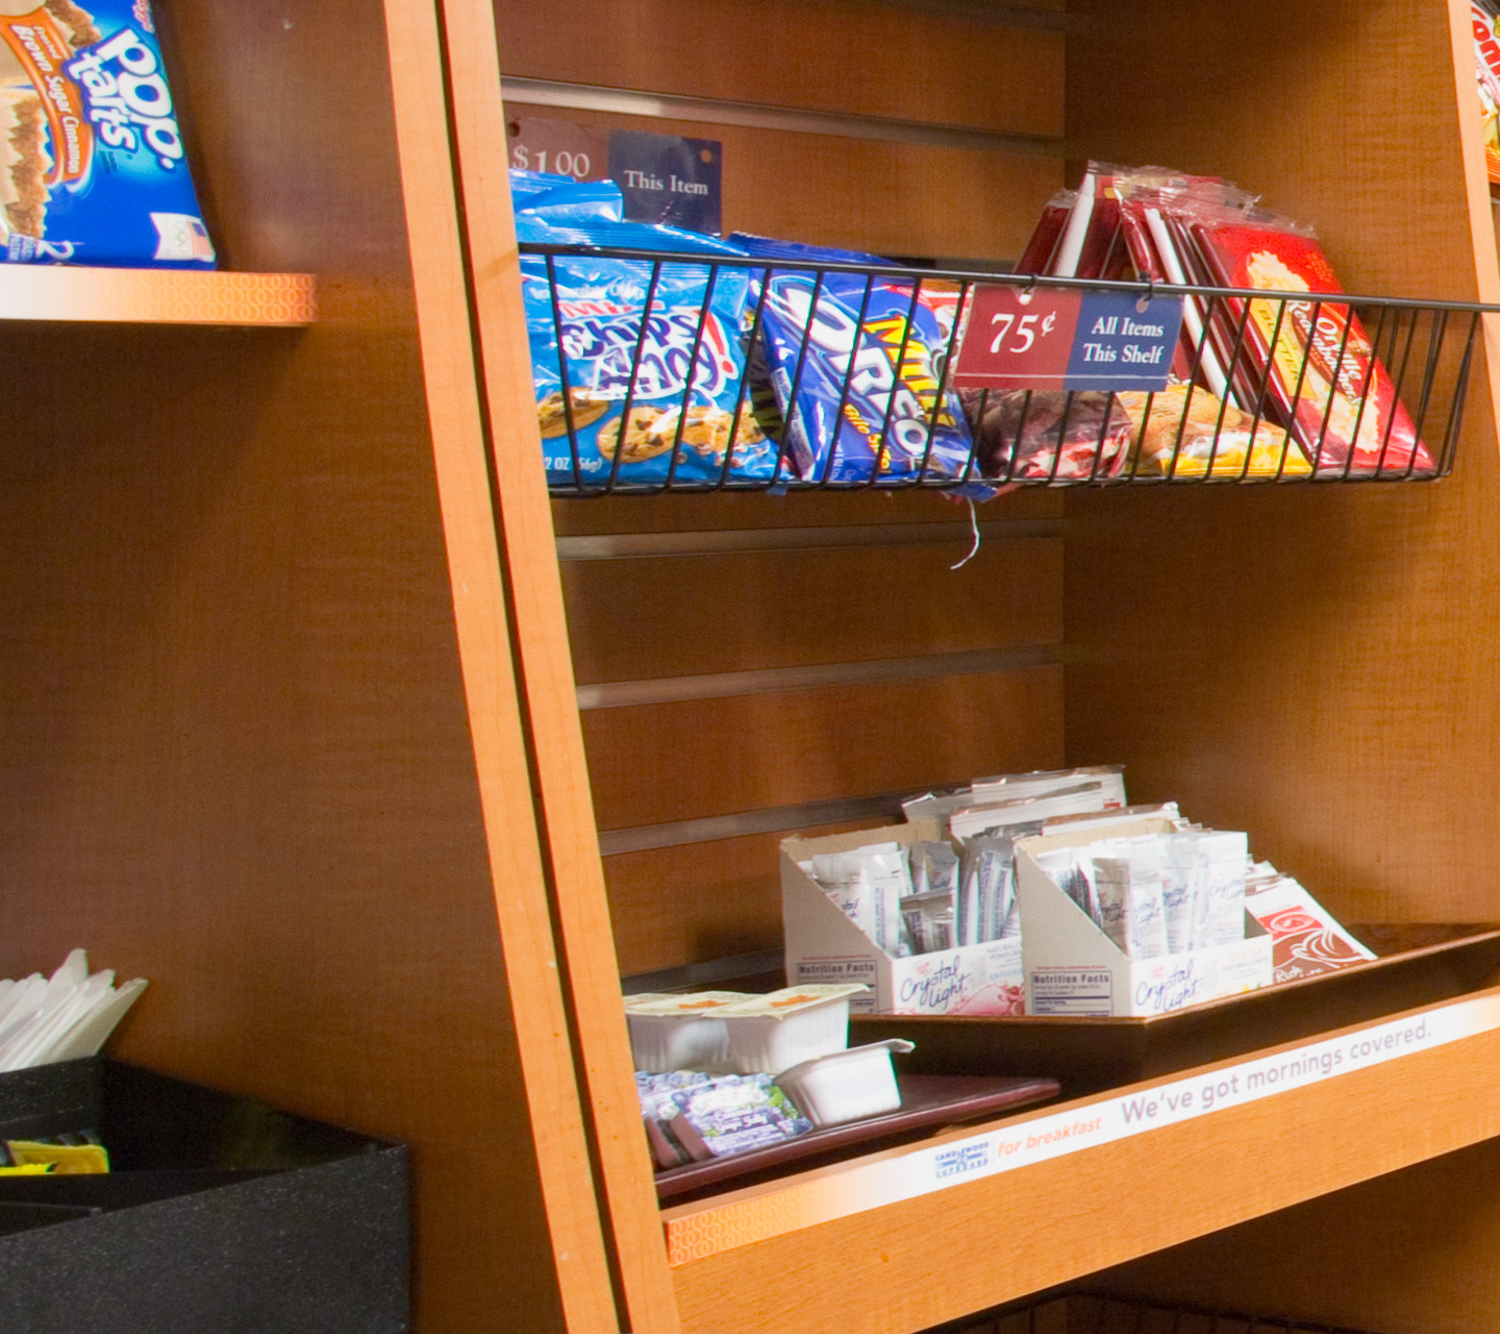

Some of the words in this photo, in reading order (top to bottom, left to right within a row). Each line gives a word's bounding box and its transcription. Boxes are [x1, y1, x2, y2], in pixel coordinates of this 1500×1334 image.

[11, 24, 53, 72] Brown
[46, 75, 73, 112] Sugar
[62, 116, 81, 174] Cinnamon
[624, 170, 664, 191] This
[670, 174, 709, 196] Item
[990, 311, 1056, 354] 75¢
[1092, 316, 1118, 336] All
[1121, 319, 1164, 337] Items
[771, 277, 931, 457] OREO
[1083, 344, 1117, 363] This
[1121, 345, 1164, 365] Shelf
[1034, 975, 1082, 985] Nutrition
[1085, 974, 1109, 984] Facts
[1121, 1088, 1192, 1125] We've
[1201, 1076, 1239, 1109] got
[1247, 1053, 1343, 1091] mornings
[1350, 1019, 1432, 1059] covered.
[997, 1138, 1021, 1157] for
[1026, 1117, 1101, 1155] breakfast
